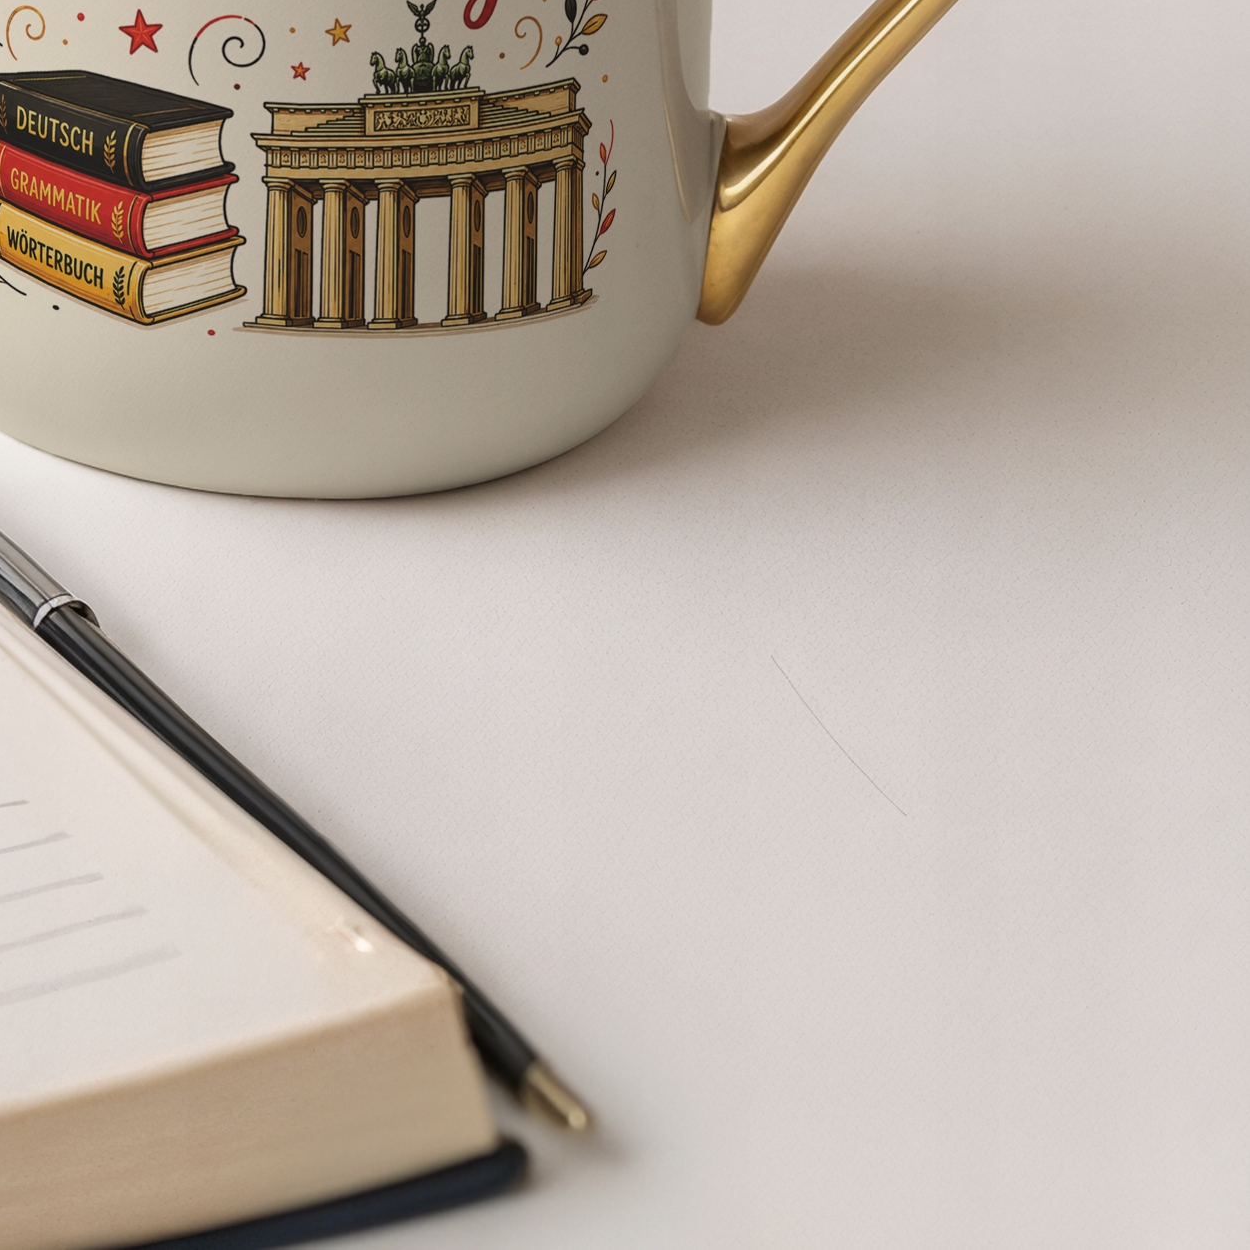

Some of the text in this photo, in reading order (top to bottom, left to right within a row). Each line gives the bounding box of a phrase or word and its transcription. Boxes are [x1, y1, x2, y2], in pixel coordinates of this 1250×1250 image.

[16, 105, 94, 156] DEUTSCH
[10, 167, 102, 225] GRAMMATIK
[6, 225, 104, 289] WÖRTERBUCH
